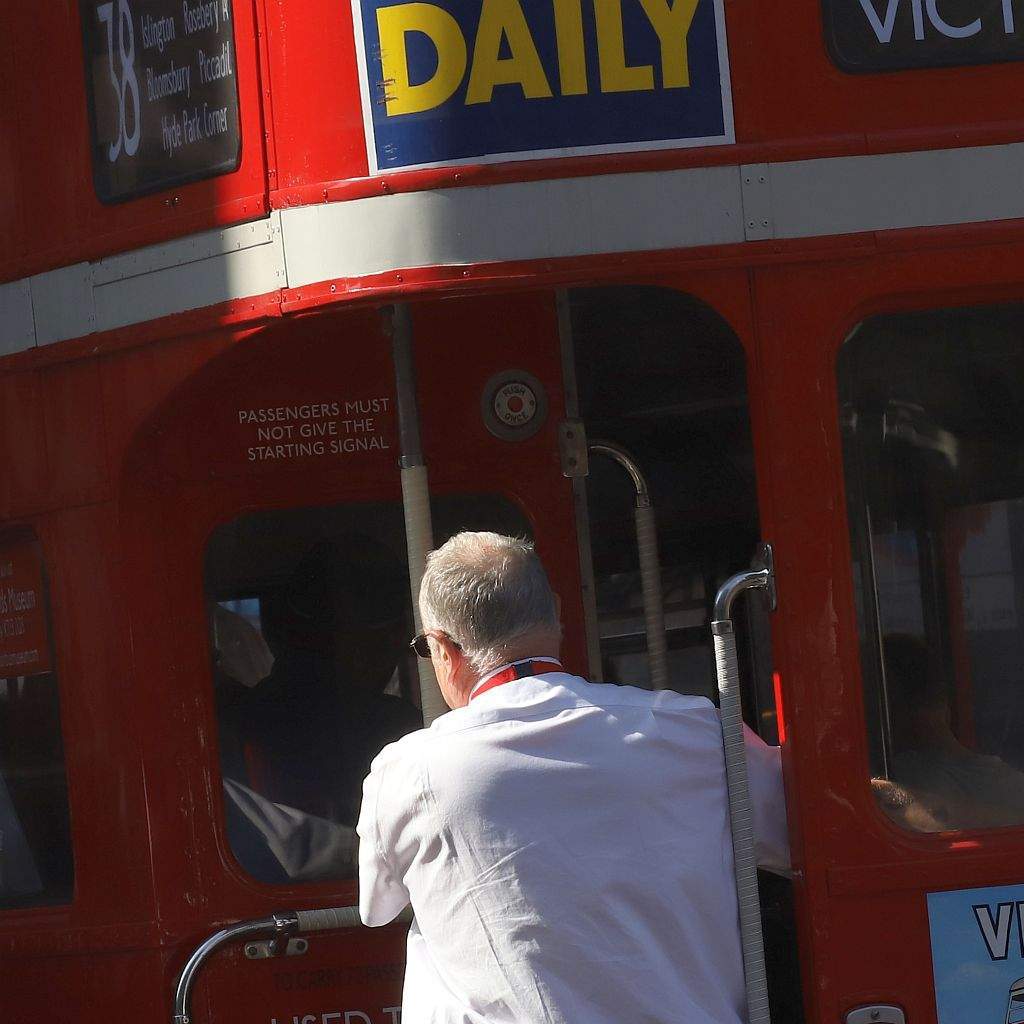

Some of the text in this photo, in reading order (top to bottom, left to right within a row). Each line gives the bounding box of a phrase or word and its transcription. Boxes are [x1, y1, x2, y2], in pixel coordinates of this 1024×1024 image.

[140, 14, 176, 53] Islington
[183, 0, 219, 35] Rosebery
[375, 0, 701, 117] DAILY
[146, 60, 191, 102] Bloomsbury
[161, 102, 228, 158] Hyde Park Corner
[238, 398, 390, 424] PASSENGERS MUST
[257, 418, 375, 441] NOT GIVE THE
[247, 436, 390, 462] STARTING SIGNAL
